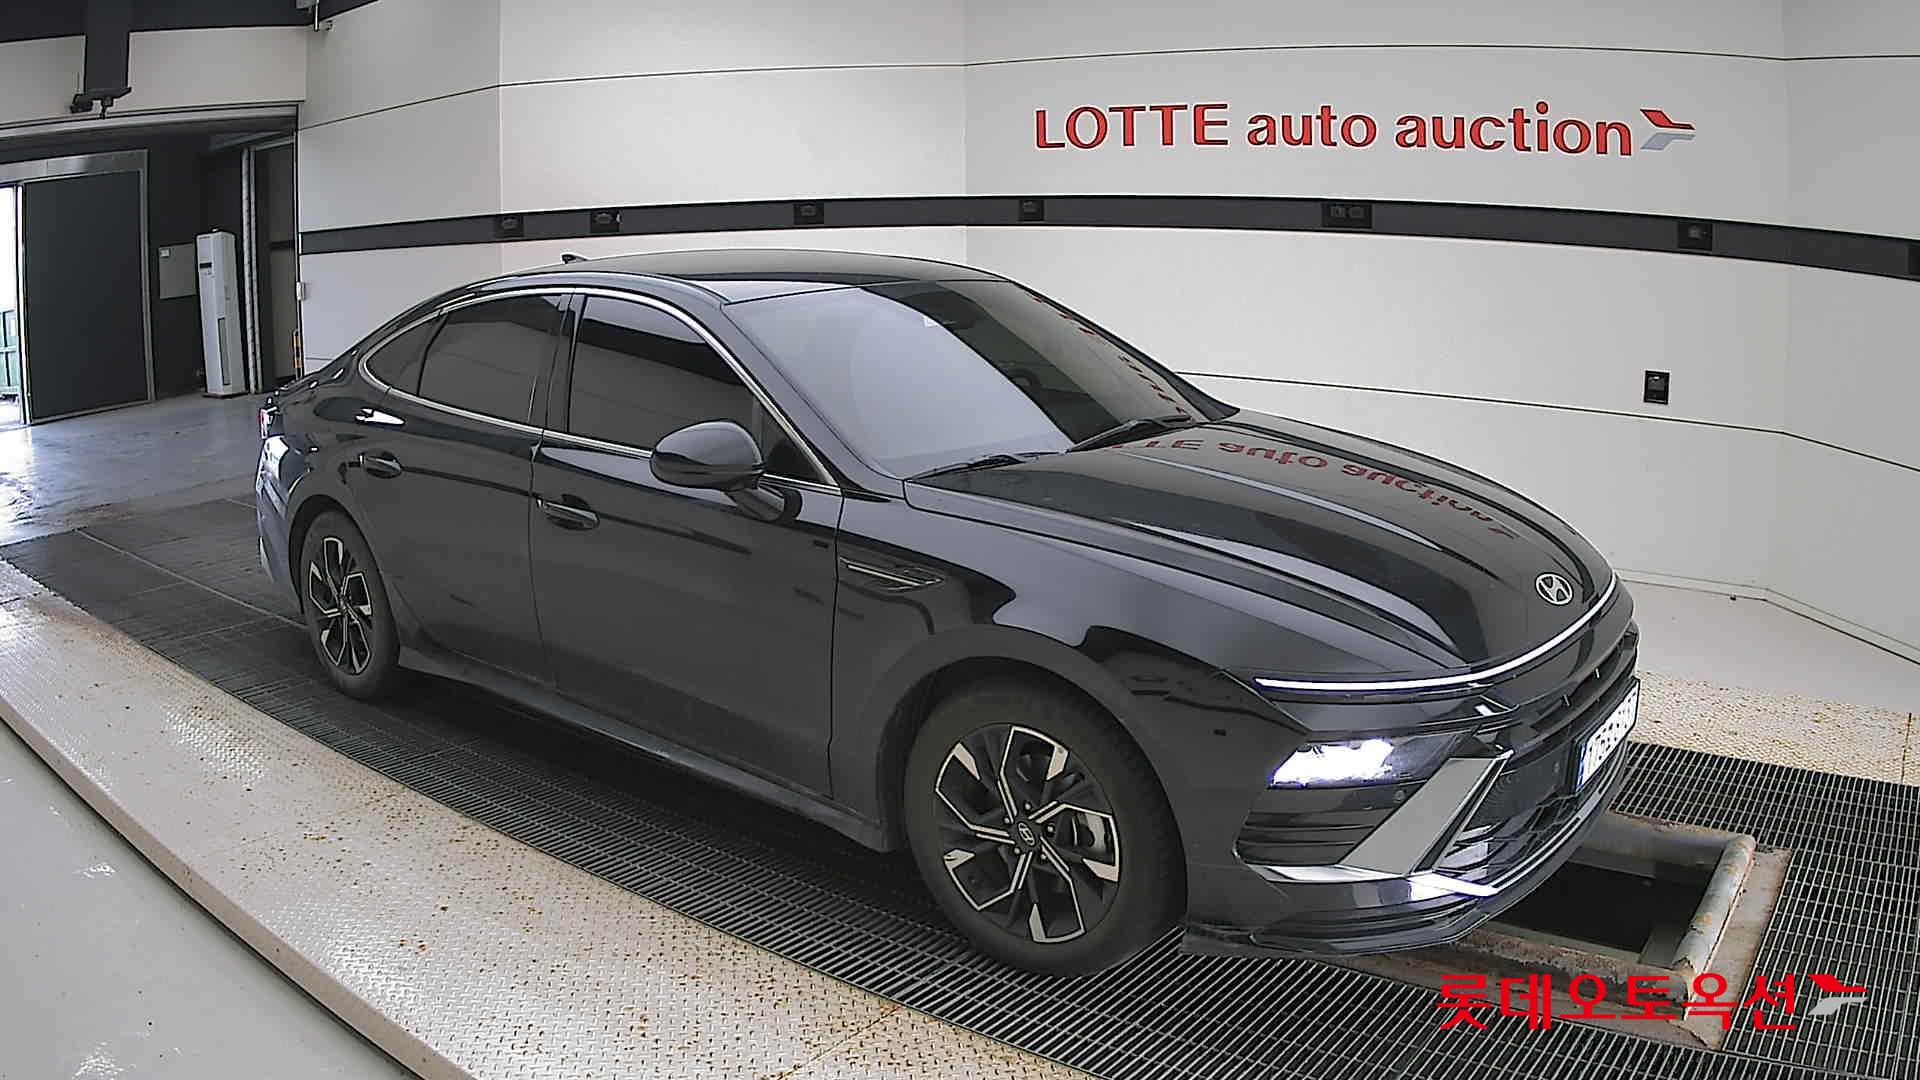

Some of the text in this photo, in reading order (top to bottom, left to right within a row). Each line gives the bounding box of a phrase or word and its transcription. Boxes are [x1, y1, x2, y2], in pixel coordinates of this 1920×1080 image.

[1035, 101, 1634, 156] LOTTE auto auction
